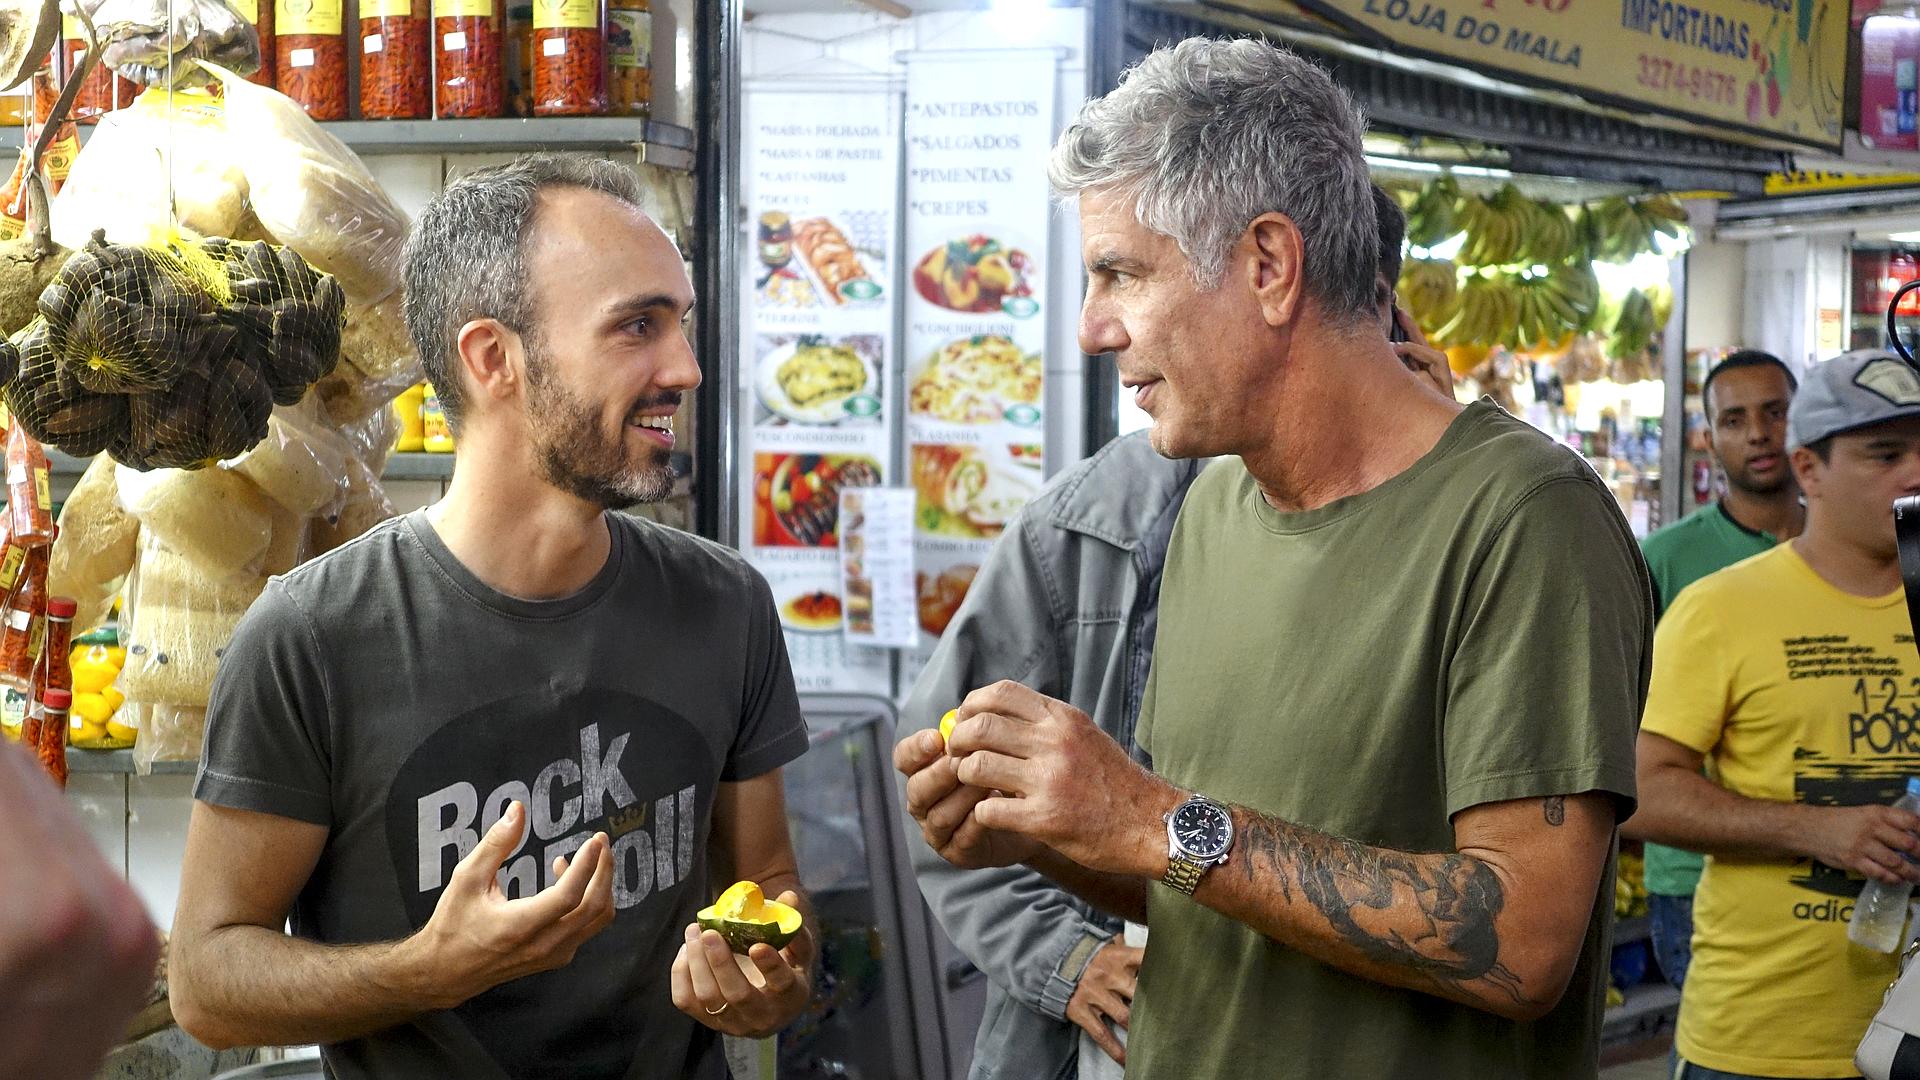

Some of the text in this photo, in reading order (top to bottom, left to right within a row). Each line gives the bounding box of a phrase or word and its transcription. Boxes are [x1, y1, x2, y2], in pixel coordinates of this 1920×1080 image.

[1363, 0, 1583, 69] LOJA DO MALA
[1621, 0, 1748, 60] IMPORTADAS
[417, 722, 638, 893] Rock
